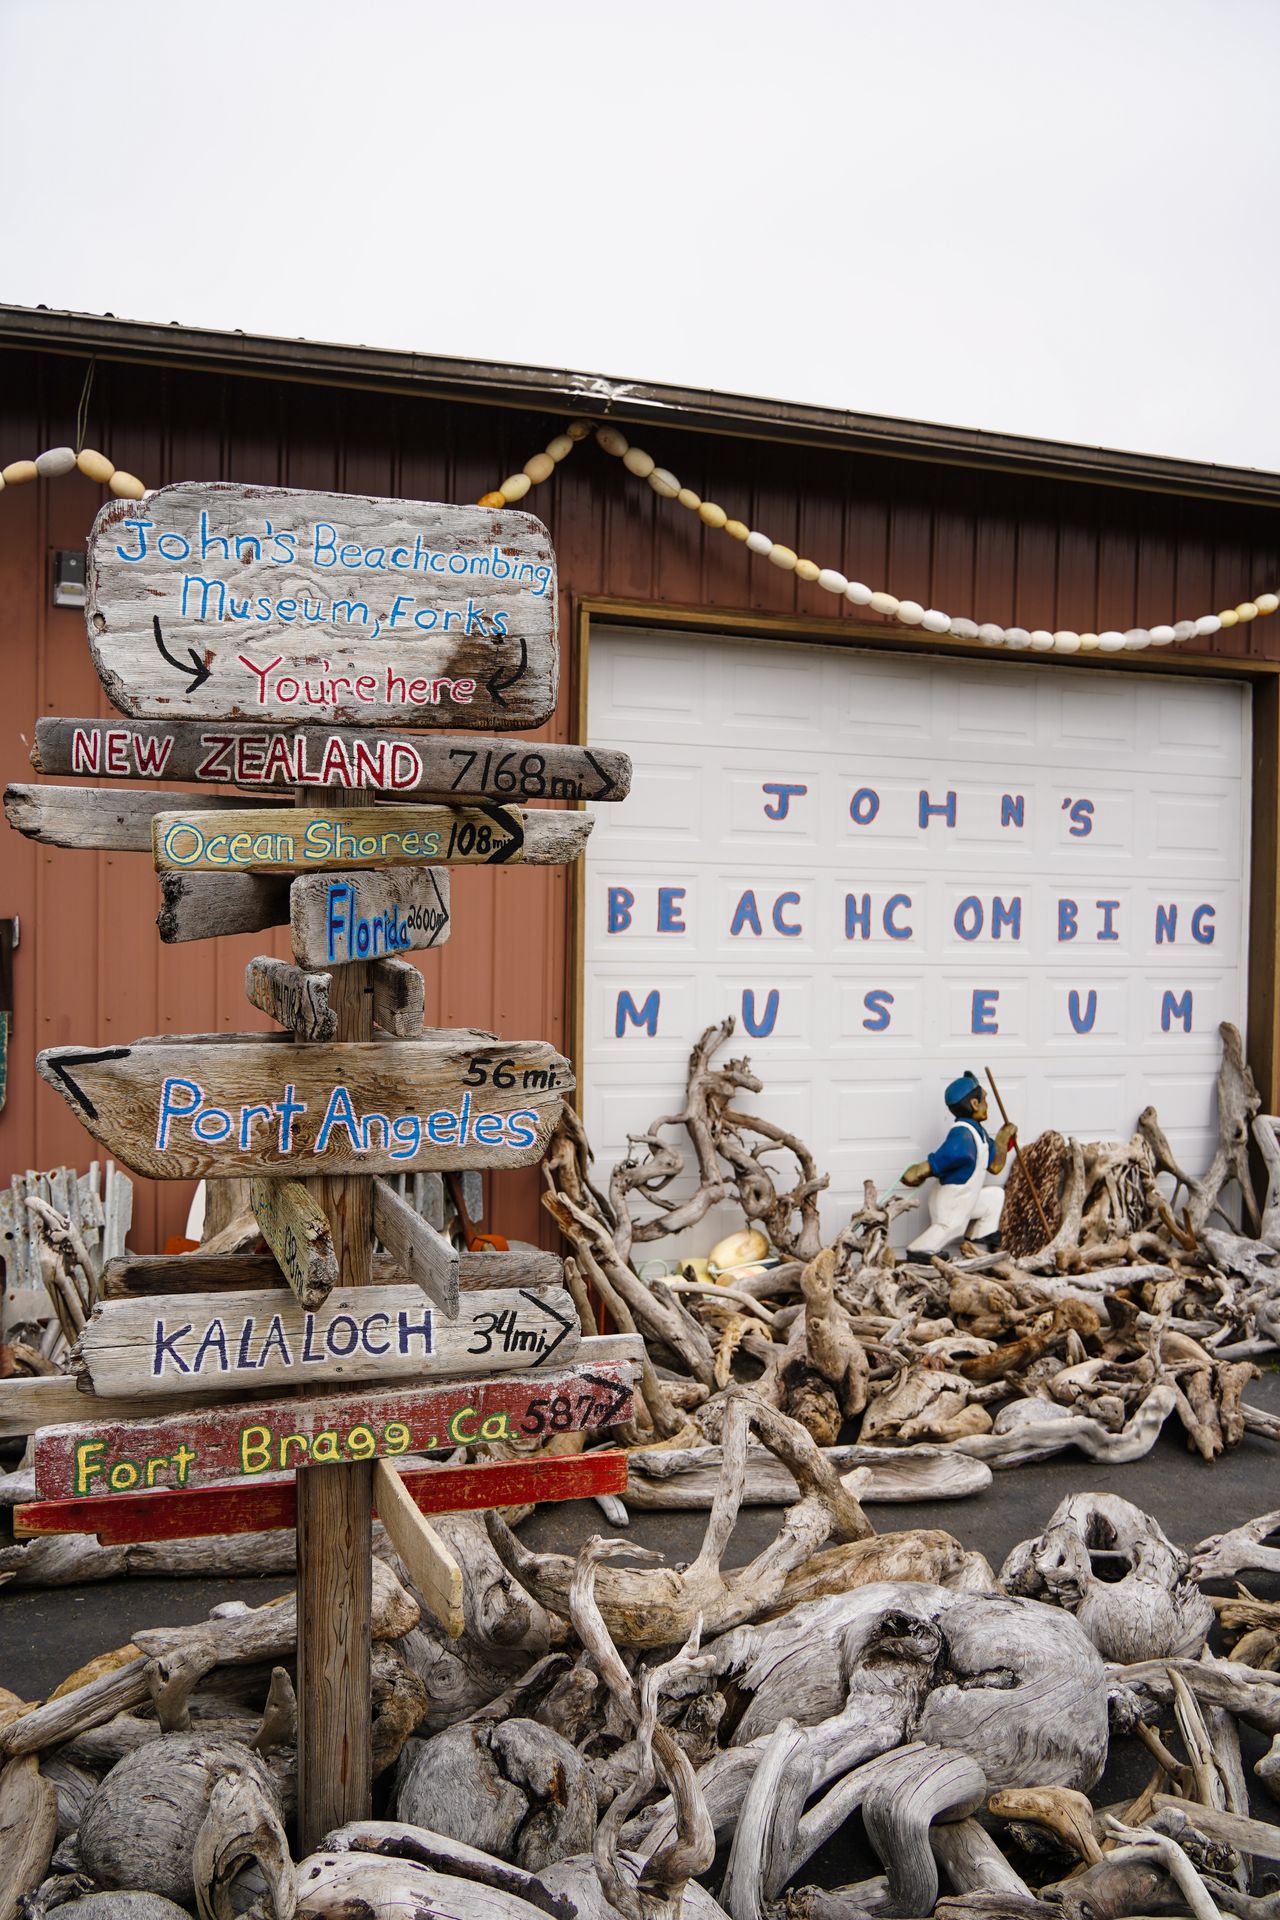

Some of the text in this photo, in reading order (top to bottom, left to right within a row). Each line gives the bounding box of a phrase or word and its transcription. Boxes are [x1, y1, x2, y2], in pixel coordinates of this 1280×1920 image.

[116, 511, 551, 596] John's Beachcombing
[389, 595, 510, 637] Forks
[238, 654, 477, 706] You're here
[72, 728, 174, 777] NEW
[196, 733, 424, 792] ZEALAND
[763, 783, 1095, 837] JOHN'S
[164, 822, 295, 866] Ocean
[303, 819, 442, 860] Shores
[327, 883, 411, 961] Florida
[607, 886, 1217, 946] BEACHCOMBING
[615, 989, 1194, 1039] MUSEUM
[463, 1057, 516, 1090] 56
[156, 1078, 541, 1160] Port Angeles
[151, 1308, 435, 1377] KALALOCH
[74, 1438, 197, 1497] Fort
